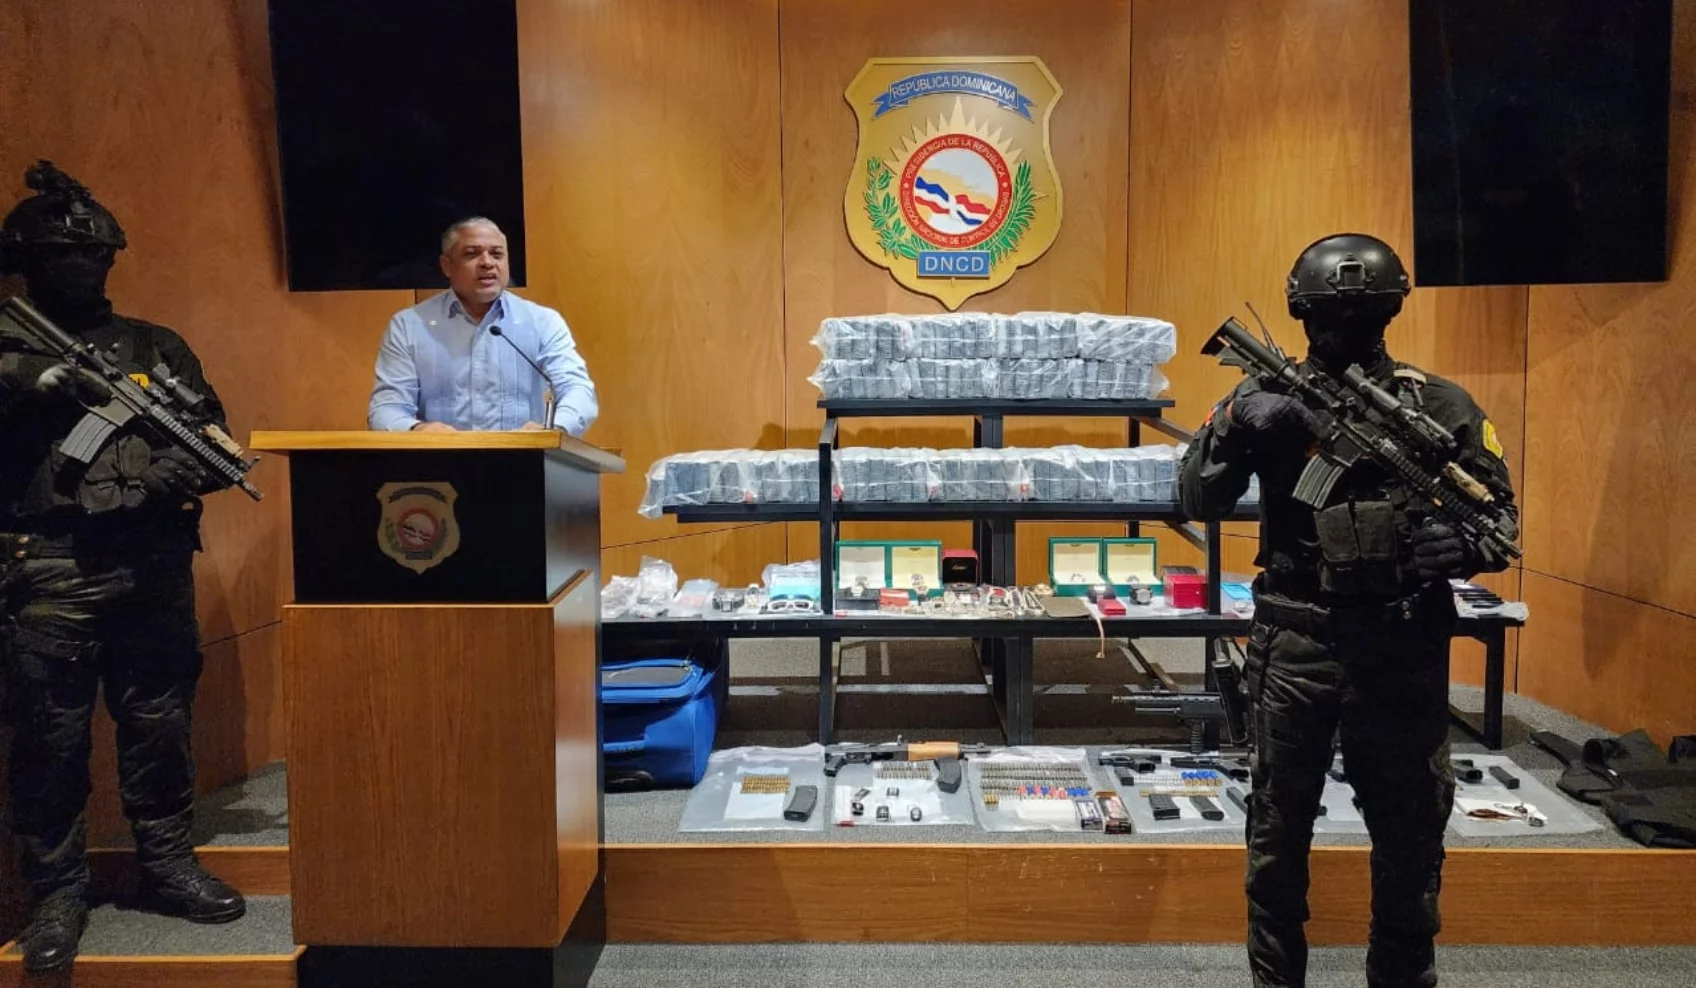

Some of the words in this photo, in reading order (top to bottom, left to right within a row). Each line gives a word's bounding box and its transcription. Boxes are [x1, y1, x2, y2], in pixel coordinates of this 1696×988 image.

[951, 75, 1016, 101] DOMINICANA
[961, 138, 972, 147] LA
[925, 256, 985, 272] DNCD
